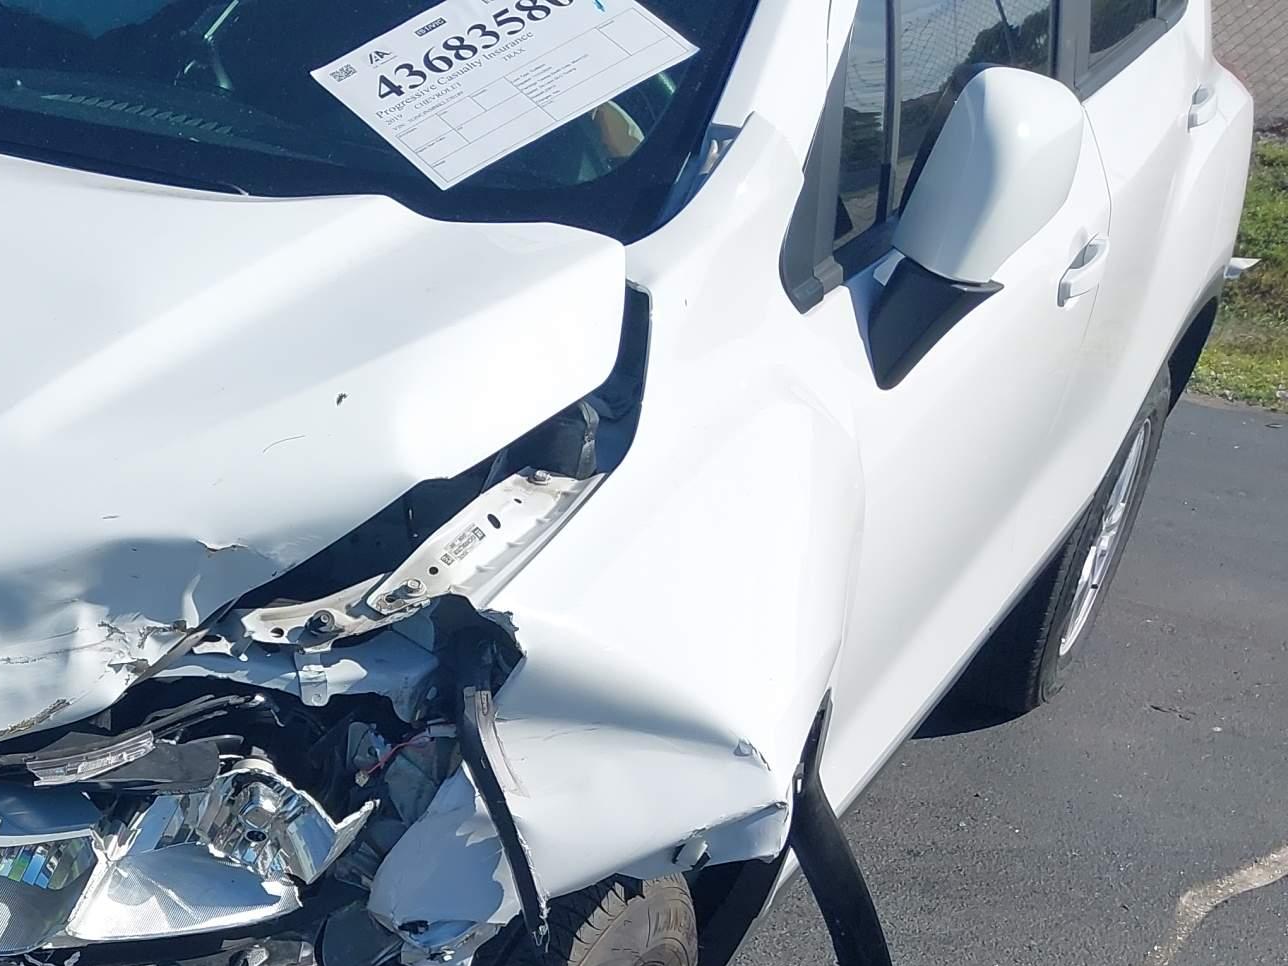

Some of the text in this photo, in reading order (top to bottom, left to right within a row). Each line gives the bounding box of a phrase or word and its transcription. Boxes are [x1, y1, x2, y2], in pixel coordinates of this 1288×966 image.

[376, 85, 437, 119] Progressive
[437, 58, 483, 86] Casualty
[483, 32, 534, 66] Insurance
[378, 0, 574, 99] 4368358
[385, 114, 403, 126] 2019
[414, 82, 462, 110] CHEVROLET
[503, 47, 526, 62] TRAX
